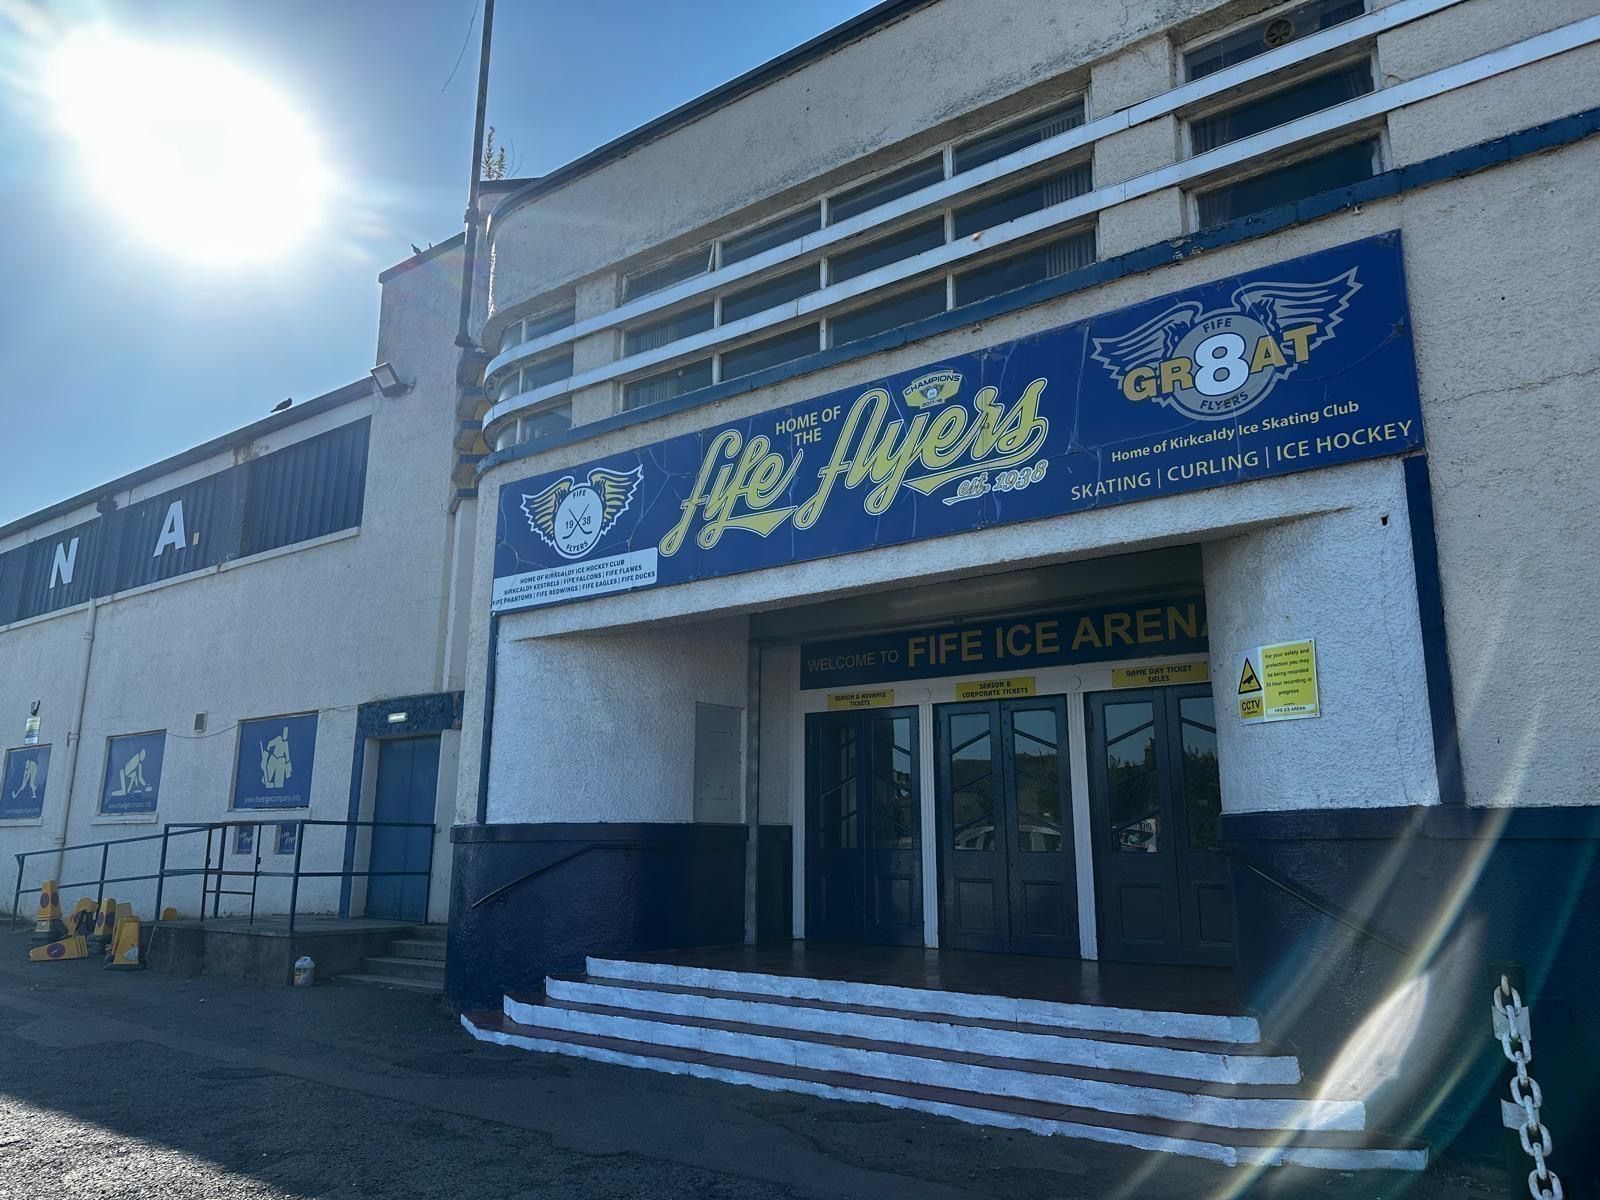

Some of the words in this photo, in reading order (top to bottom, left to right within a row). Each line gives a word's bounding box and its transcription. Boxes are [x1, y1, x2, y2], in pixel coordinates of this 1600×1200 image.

[1203, 317, 1233, 334] FIFE
[904, 374, 961, 396] CHAMPIONS
[1200, 390, 1249, 411] FLYERS
[775, 411, 818, 436] HOME
[821, 405, 841, 423] OF
[794, 427, 822, 447] THE
[1111, 448, 1151, 463] Home
[1153, 439, 1168, 454] of
[1170, 426, 1236, 450] Kirkcaldy
[1238, 423, 1259, 436] Ice
[1262, 411, 1320, 431] Skating
[1323, 401, 1360, 418] Club
[1071, 472, 1151, 501] SKATING
[1167, 451, 1259, 482] CURLING
[1276, 440, 1310, 462] ICE
[1316, 419, 1413, 454] HOCKEY
[991, 459, 1049, 493] 1938
[573, 489, 587, 499] FIFE
[565, 519, 574, 529] 19
[582, 515, 592, 526] 38
[565, 541, 589, 552] FLYERS
[504, 585, 533, 595] KIRKCALDY
[533, 580, 560, 590] KESTRELS
[563, 577, 575, 585] FIFE
[576, 572, 602, 582] FALCONS
[605, 569, 618, 577] FIFE
[619, 564, 643, 574] FLAMES
[519, 576, 536, 584] HOME
[544, 569, 575, 580] KIRKCALDY
[575, 566, 585, 574] ICE
[585, 562, 609, 572] HOCKEY
[609, 559, 625, 567] CLUB
[503, 593, 533, 604] PHANTOMS
[536, 590, 548, 598] FIFE
[548, 585, 578, 596] REDWINGS
[582, 582, 595, 590] FIFE
[595, 578, 618, 588] EAGLES
[621, 574, 634, 583] FIFE
[634, 570, 656, 580] DUCKS
[808, 651, 876, 673] WELCOME
[880, 649, 899, 664] TO
[907, 629, 983, 668] FIFE
[995, 620, 1060, 659] ICE
[1125, 668, 1148, 677] GAME
[1148, 667, 1166, 675] DAY
[1166, 664, 1192, 674] TICKET
[1148, 674, 1170, 683] SALES
[962, 689, 1001, 698] CORPORATE
[1002, 687, 1029, 696] TICKETS
[979, 680, 1005, 689] SEASON
[849, 699, 871, 707] TICKETS
[861, 691, 887, 699] ADVANCE
[1241, 699, 1261, 711] CCTV
